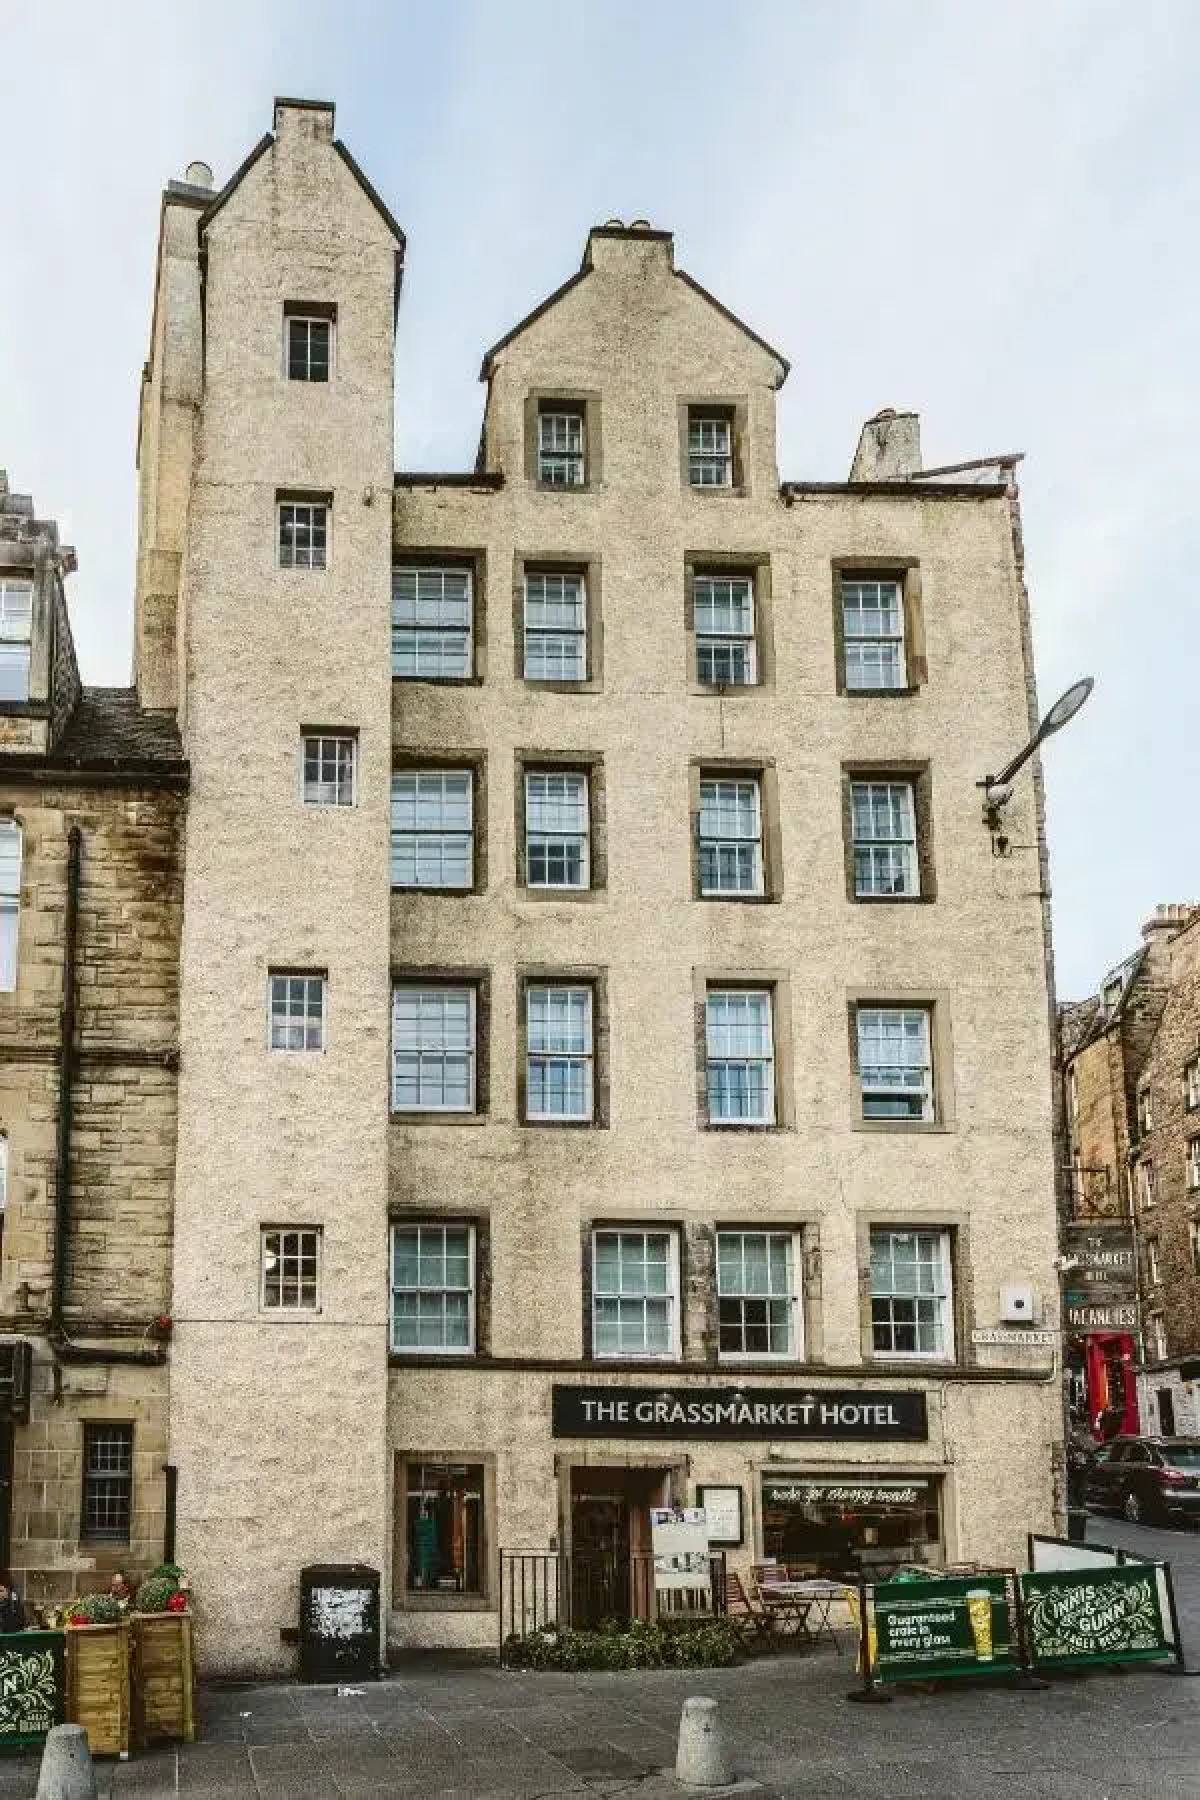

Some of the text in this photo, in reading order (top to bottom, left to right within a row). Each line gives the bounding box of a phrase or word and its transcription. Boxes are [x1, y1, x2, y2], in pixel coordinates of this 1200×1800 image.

[581, 1401, 899, 1426] THE GRASSMARKET HOTEL
[1052, 1585, 1096, 1619] INNIS
[1079, 1599, 1125, 1631] GUNN
